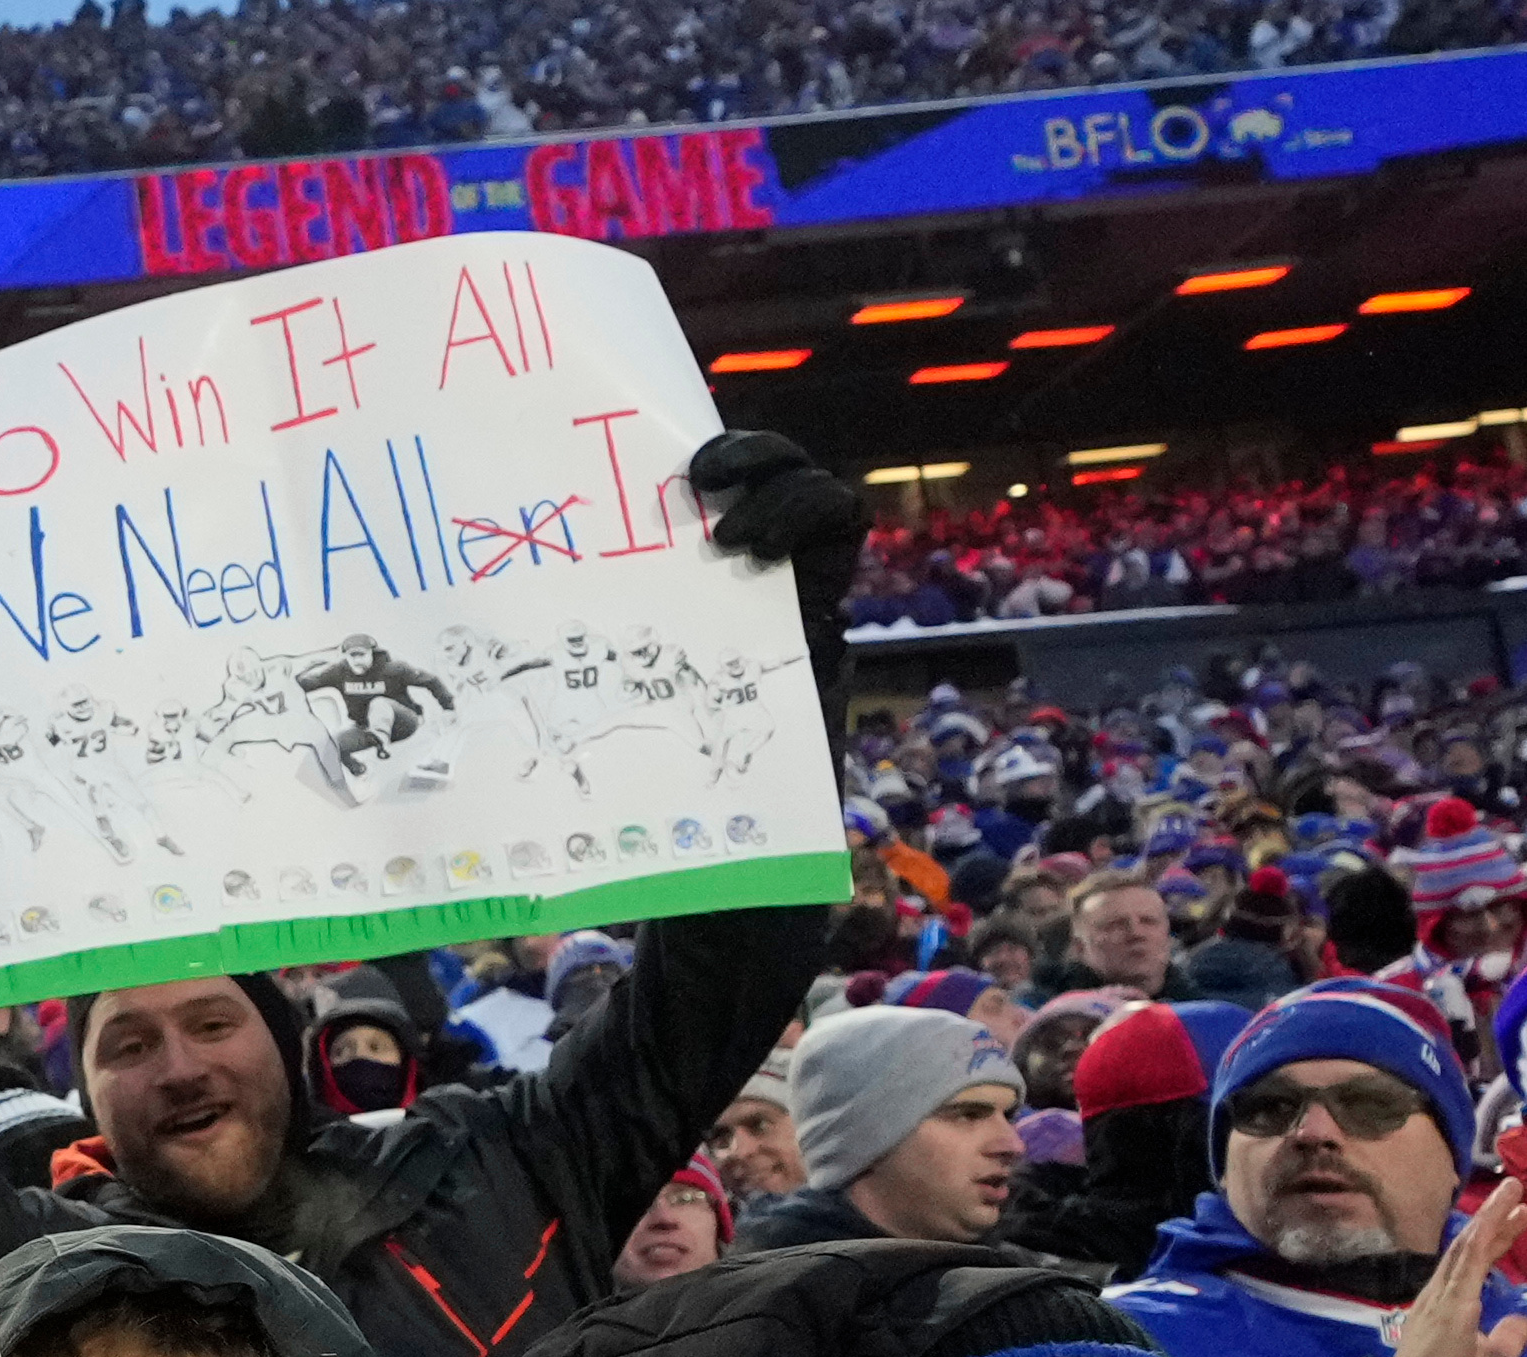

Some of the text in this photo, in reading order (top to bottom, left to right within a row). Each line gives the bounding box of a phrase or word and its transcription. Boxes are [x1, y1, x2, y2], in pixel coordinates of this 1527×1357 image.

[134, 154, 452, 276] LEGEND
[525, 127, 774, 239] GAME
[1044, 105, 1210, 170] BFLO
[58, 336, 229, 463] Win
[250, 296, 377, 431] It
[439, 261, 553, 390] All
[116, 480, 291, 639] Need
